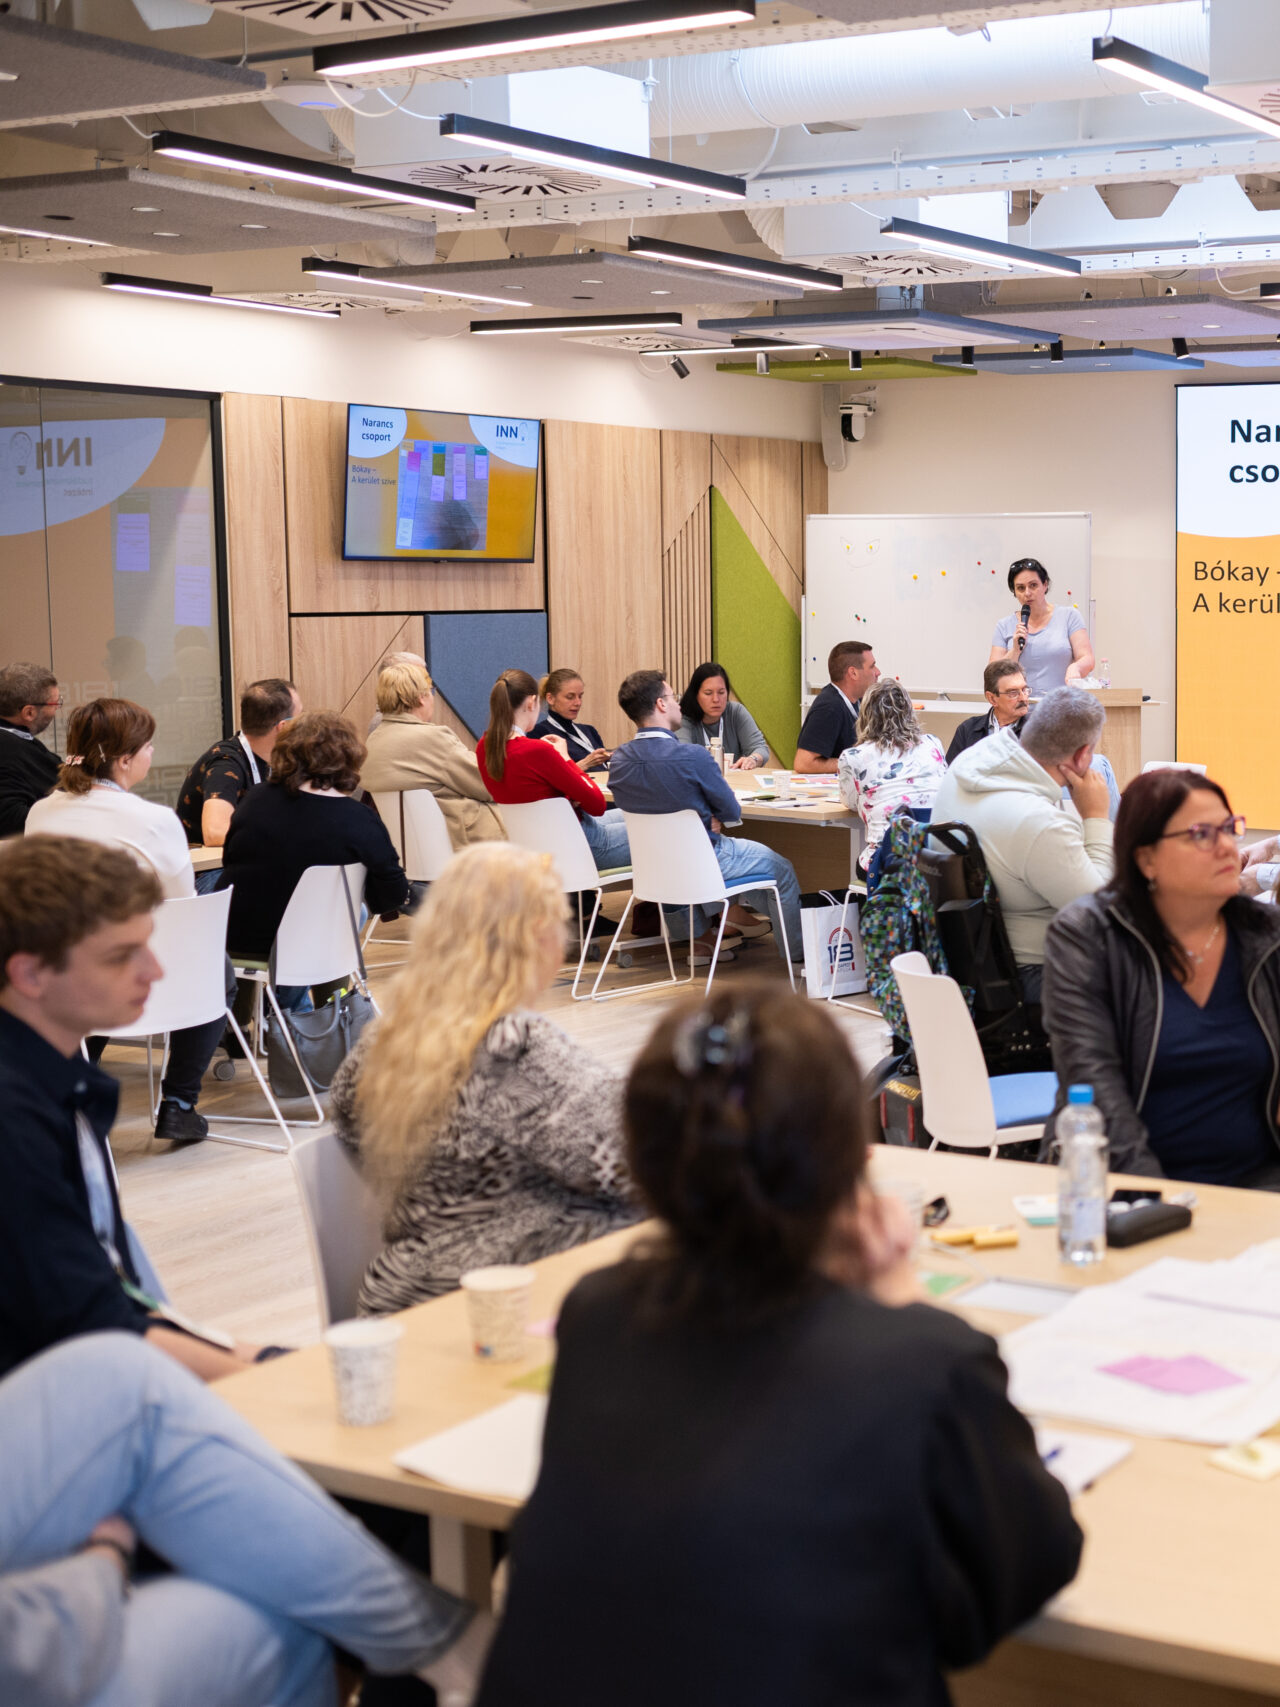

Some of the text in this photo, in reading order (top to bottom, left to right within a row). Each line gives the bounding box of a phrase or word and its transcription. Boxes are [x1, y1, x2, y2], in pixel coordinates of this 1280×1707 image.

[362, 417, 394, 429] Narancs
[361, 432, 391, 443] csoport
[1195, 560, 1269, 586] Bókay
[1193, 593, 1209, 612] A
